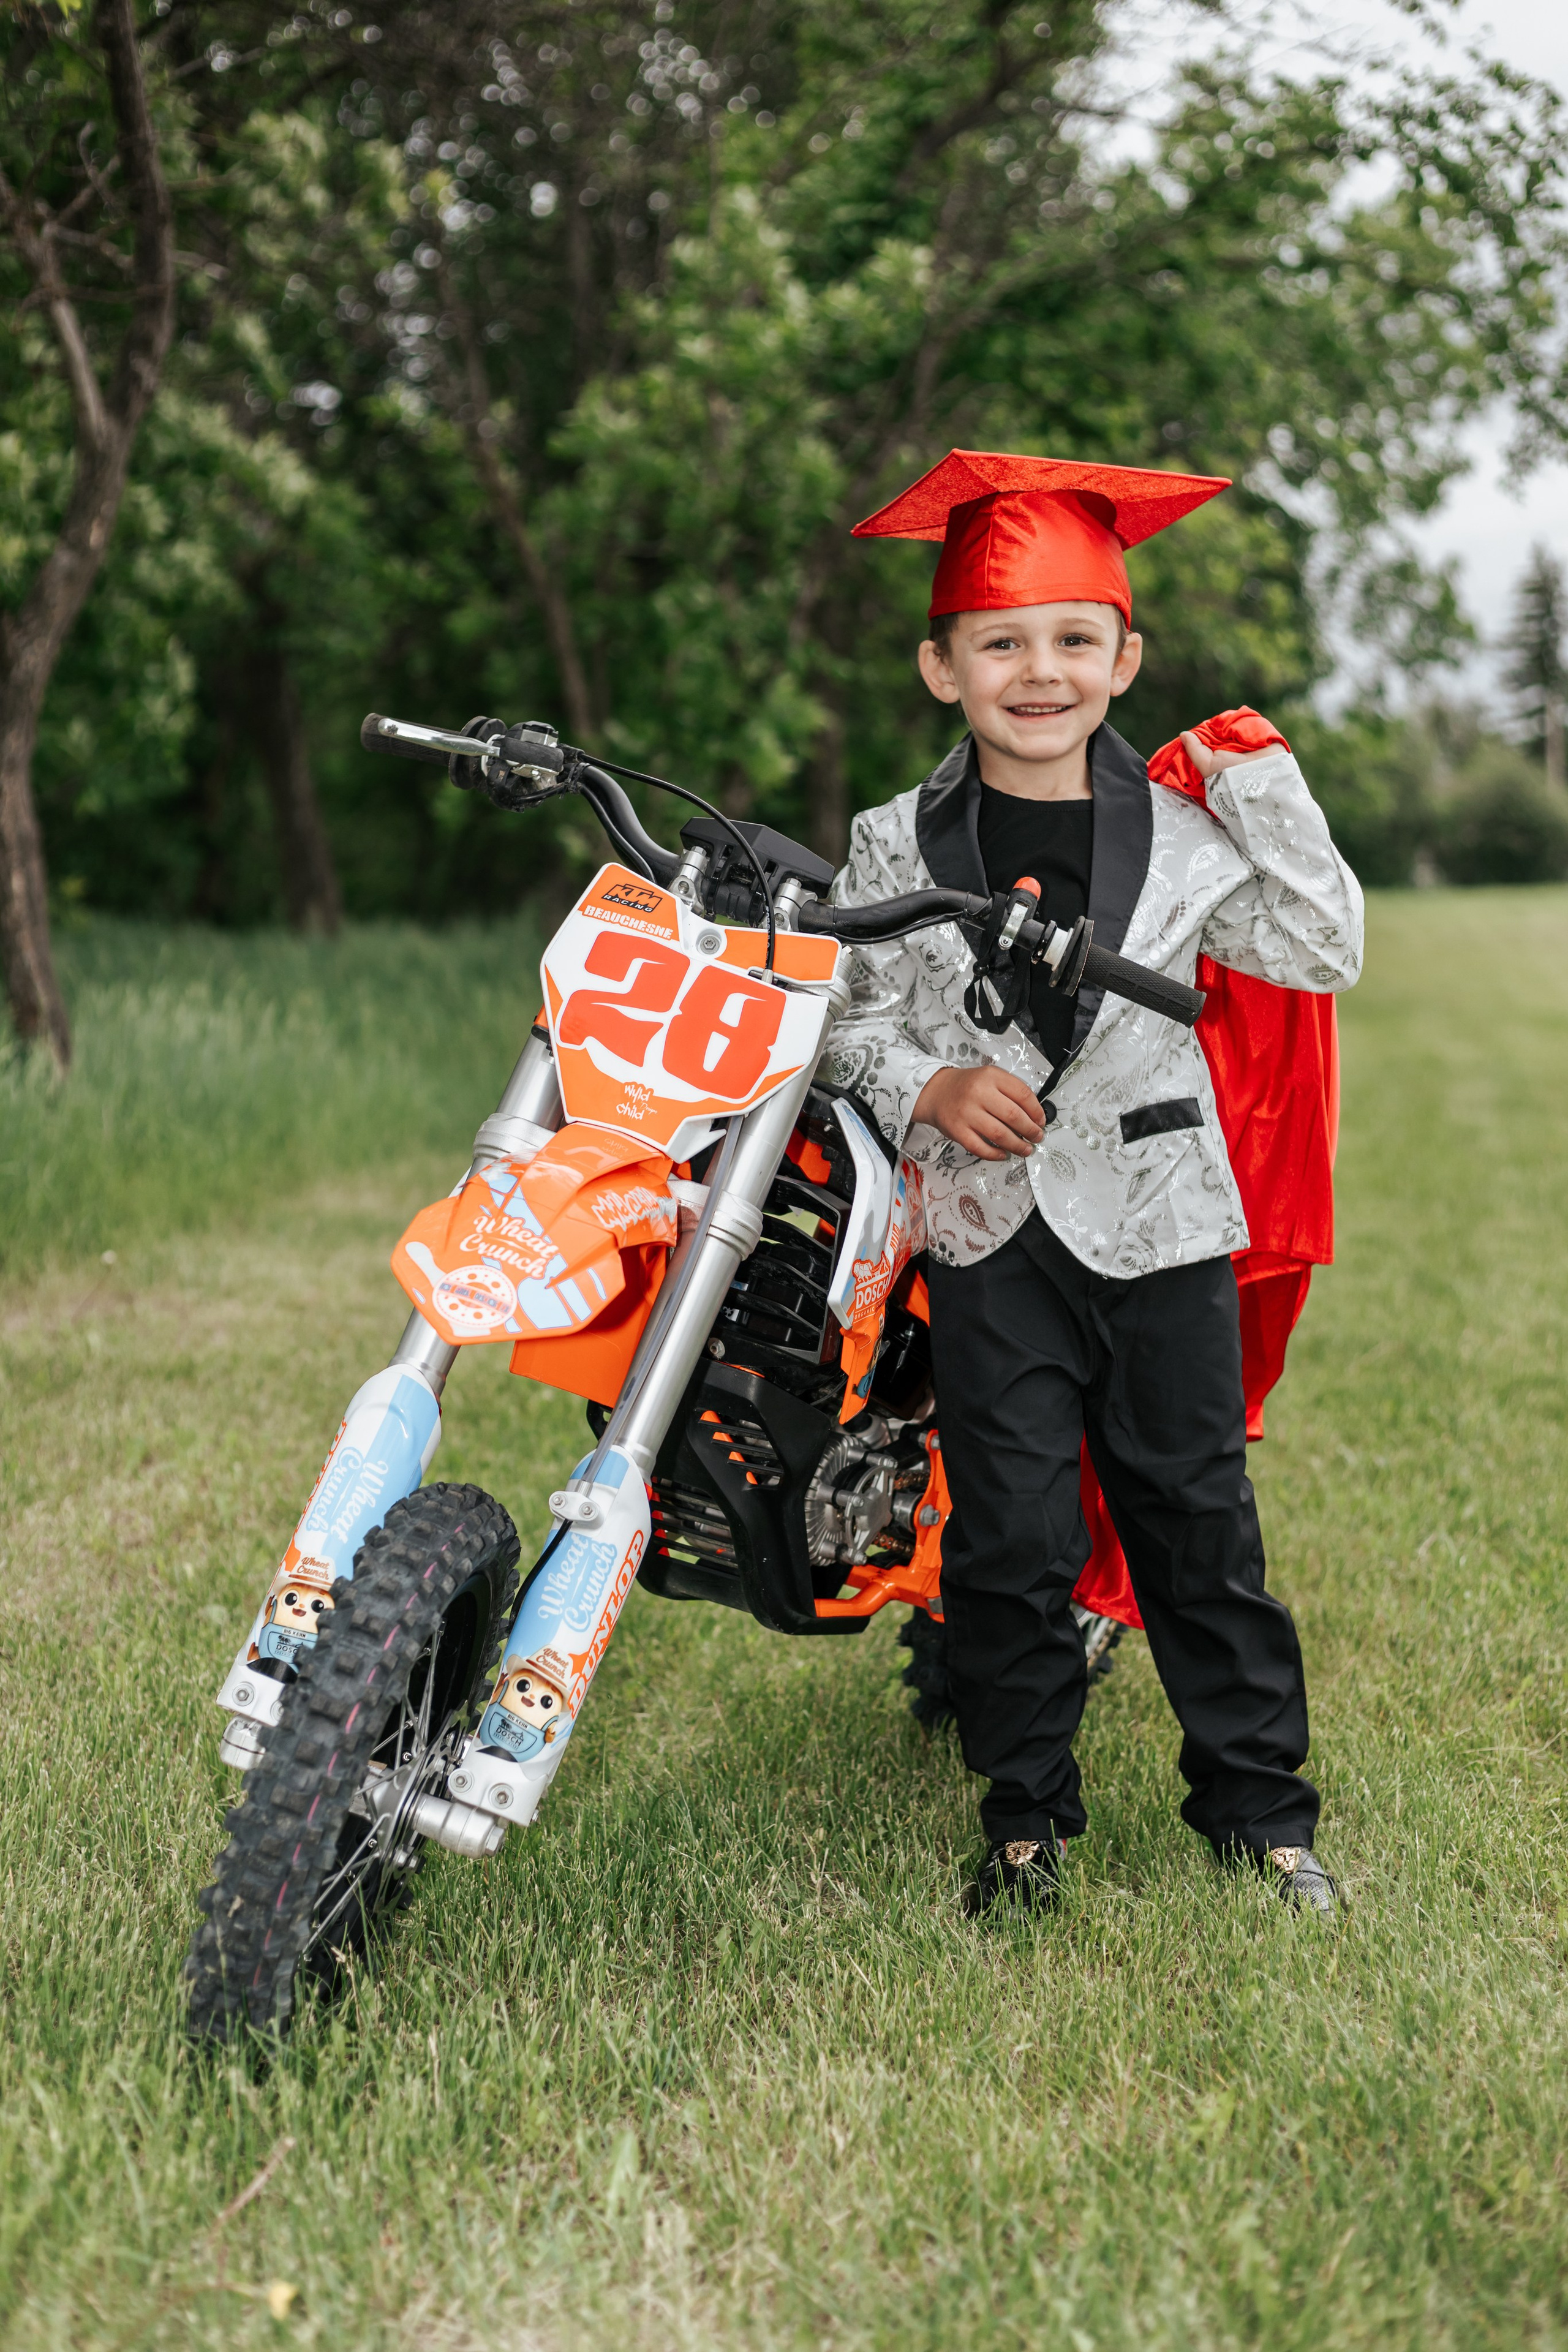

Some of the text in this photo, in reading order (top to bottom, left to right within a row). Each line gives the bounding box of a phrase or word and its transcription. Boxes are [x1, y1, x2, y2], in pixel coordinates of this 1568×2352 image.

[603, 895, 653, 912] RACING
[606, 884, 663, 908] KTM
[584, 905, 673, 939] BEAUCHESNE
[559, 930, 786, 1099] 28
[473, 1216, 559, 1258] Wheat
[459, 1234, 546, 1278] Crunch
[856, 1278, 888, 1309] DOSCH
[854, 1306, 875, 1320] ORGANIC
[308, 1449, 361, 1530] Crunch
[331, 1460, 388, 1544] Wheat
[296, 1566, 329, 1580] Crunch
[301, 1557, 330, 1570] Wheat
[538, 1532, 589, 1619] Wheat
[564, 1544, 616, 1630] Crunch
[567, 1530, 644, 1720] DUNLOP
[276, 1644, 298, 1654] DOSC
[543, 1648, 568, 1669] Wheat
[536, 1655, 565, 1679] Crunch
[496, 1727, 522, 1746] DOSCH
